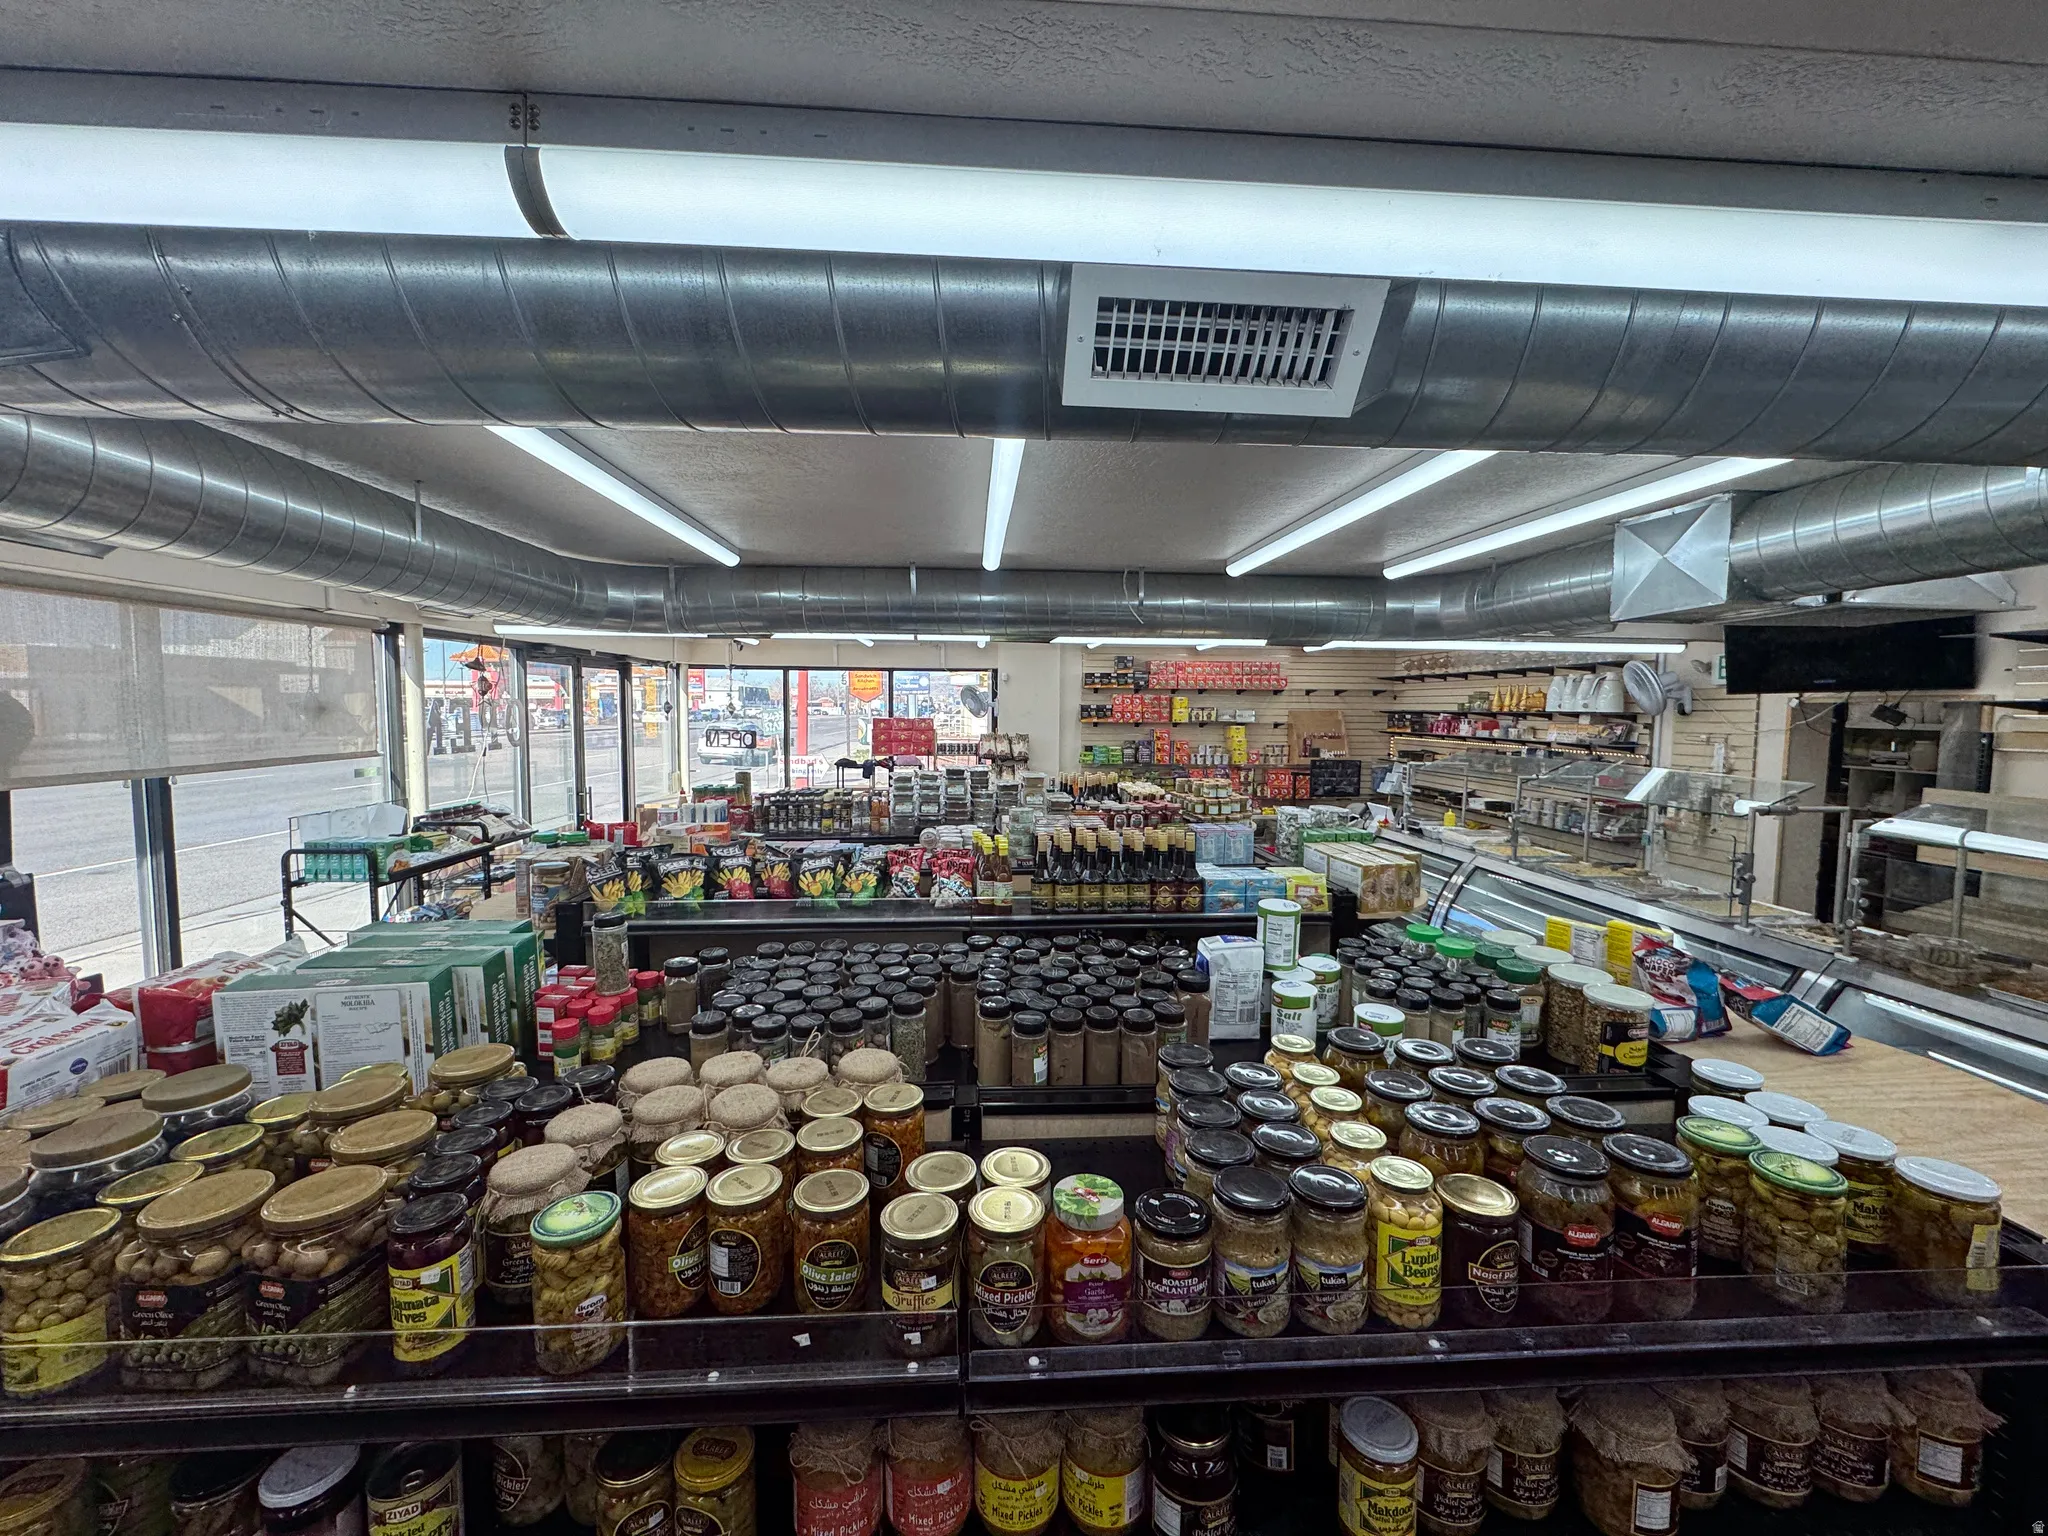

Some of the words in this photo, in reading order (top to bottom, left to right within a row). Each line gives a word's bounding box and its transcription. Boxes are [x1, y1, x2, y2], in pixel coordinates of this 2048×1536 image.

[780, 756, 824, 765] Sndbad's
[719, 856, 752, 868] ASEEL
[802, 856, 835, 870] ASEEL
[1644, 956, 1676, 969] CHOCO
[1644, 964, 1675, 977] WAFER
[1318, 983, 1339, 994] Salt
[340, 999, 376, 1007] MOLOKHIA
[1276, 1008, 1303, 1021] Salt
[510, 1241, 532, 1250] ALRE
[672, 1250, 700, 1269] Olive
[1083, 1256, 1107, 1265] Sera
[802, 1264, 826, 1281] Olive
[828, 1267, 858, 1283] Salad
[1402, 1262, 1439, 1279] Beans
[1472, 1267, 1502, 1280] Najaf
[1162, 1277, 1199, 1287] ROASTED
[975, 1284, 1001, 1303] Mixed
[1003, 1288, 1036, 1304] Pickles
[1084, 1287, 1106, 1296] Garlic
[255, 1300, 274, 1310] Green
[577, 1296, 605, 1312] ikram
[891, 1291, 937, 1311] Truffles
[132, 1310, 153, 1319] Green
[153, 1311, 175, 1319] Olive
[387, 1504, 420, 1521] ZIYAD
[908, 1514, 934, 1525] Mixed
[938, 1501, 964, 1522] Pickles
[991, 1505, 1014, 1521] Mixed
[1018, 1505, 1043, 1521] Pickles
[1078, 1497, 1104, 1518] Pickles
[810, 1523, 835, 1536] Mixed
[840, 1516, 869, 1536] Pickles
